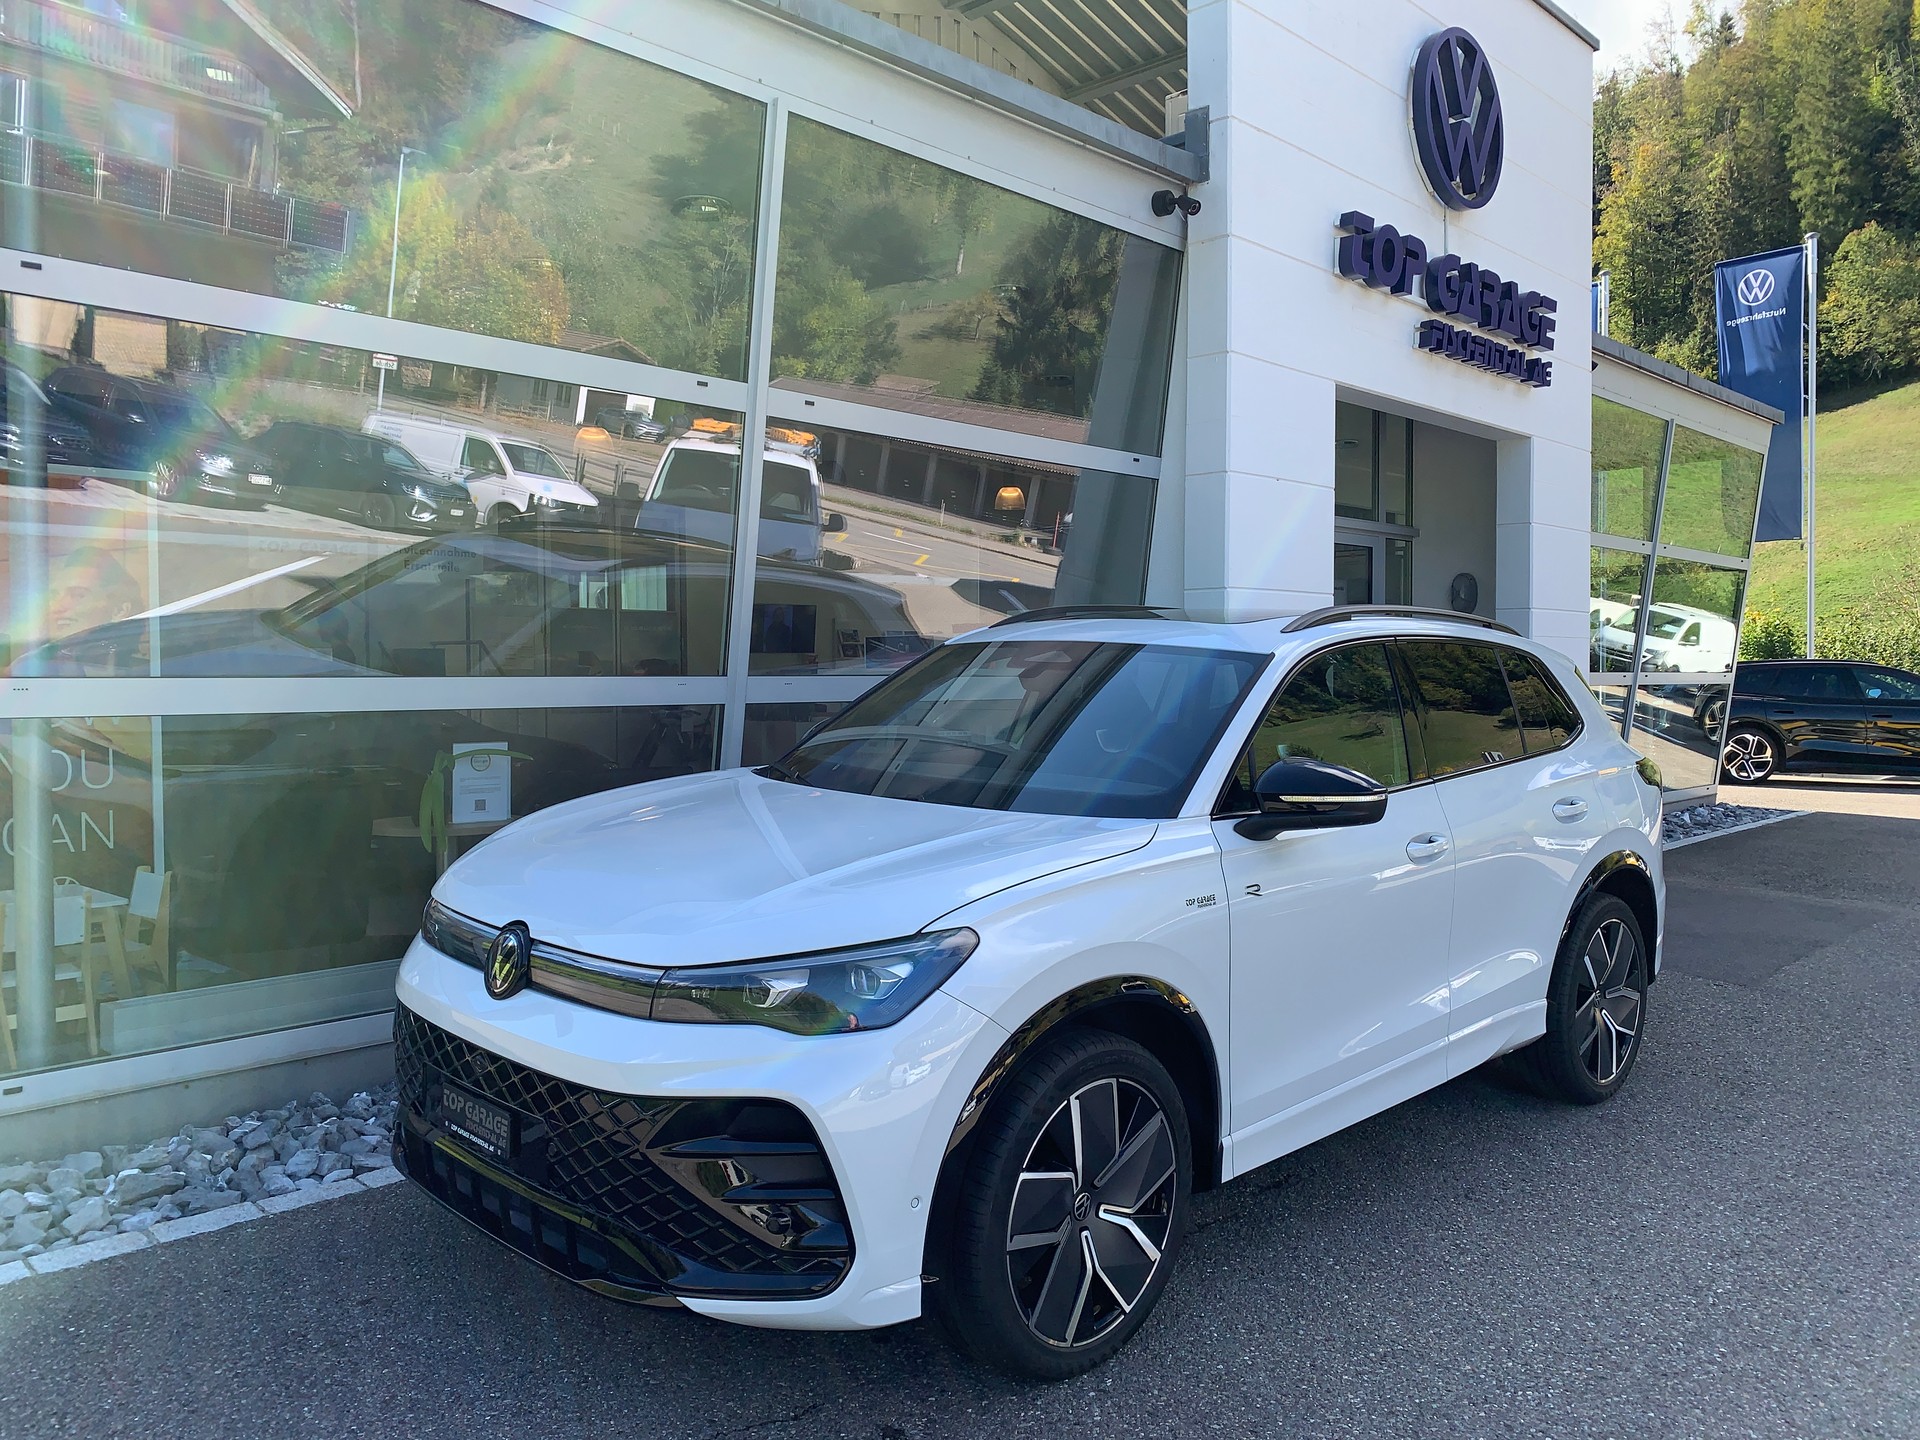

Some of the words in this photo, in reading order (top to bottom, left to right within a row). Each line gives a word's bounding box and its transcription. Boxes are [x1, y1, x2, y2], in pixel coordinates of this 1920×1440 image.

[1339, 210, 1427, 297] TOP
[1425, 254, 1557, 352] GARAGE
[1524, 357, 1553, 388] AG
[443, 1088, 465, 1113] TOP
[465, 1101, 509, 1138] GARAGE
